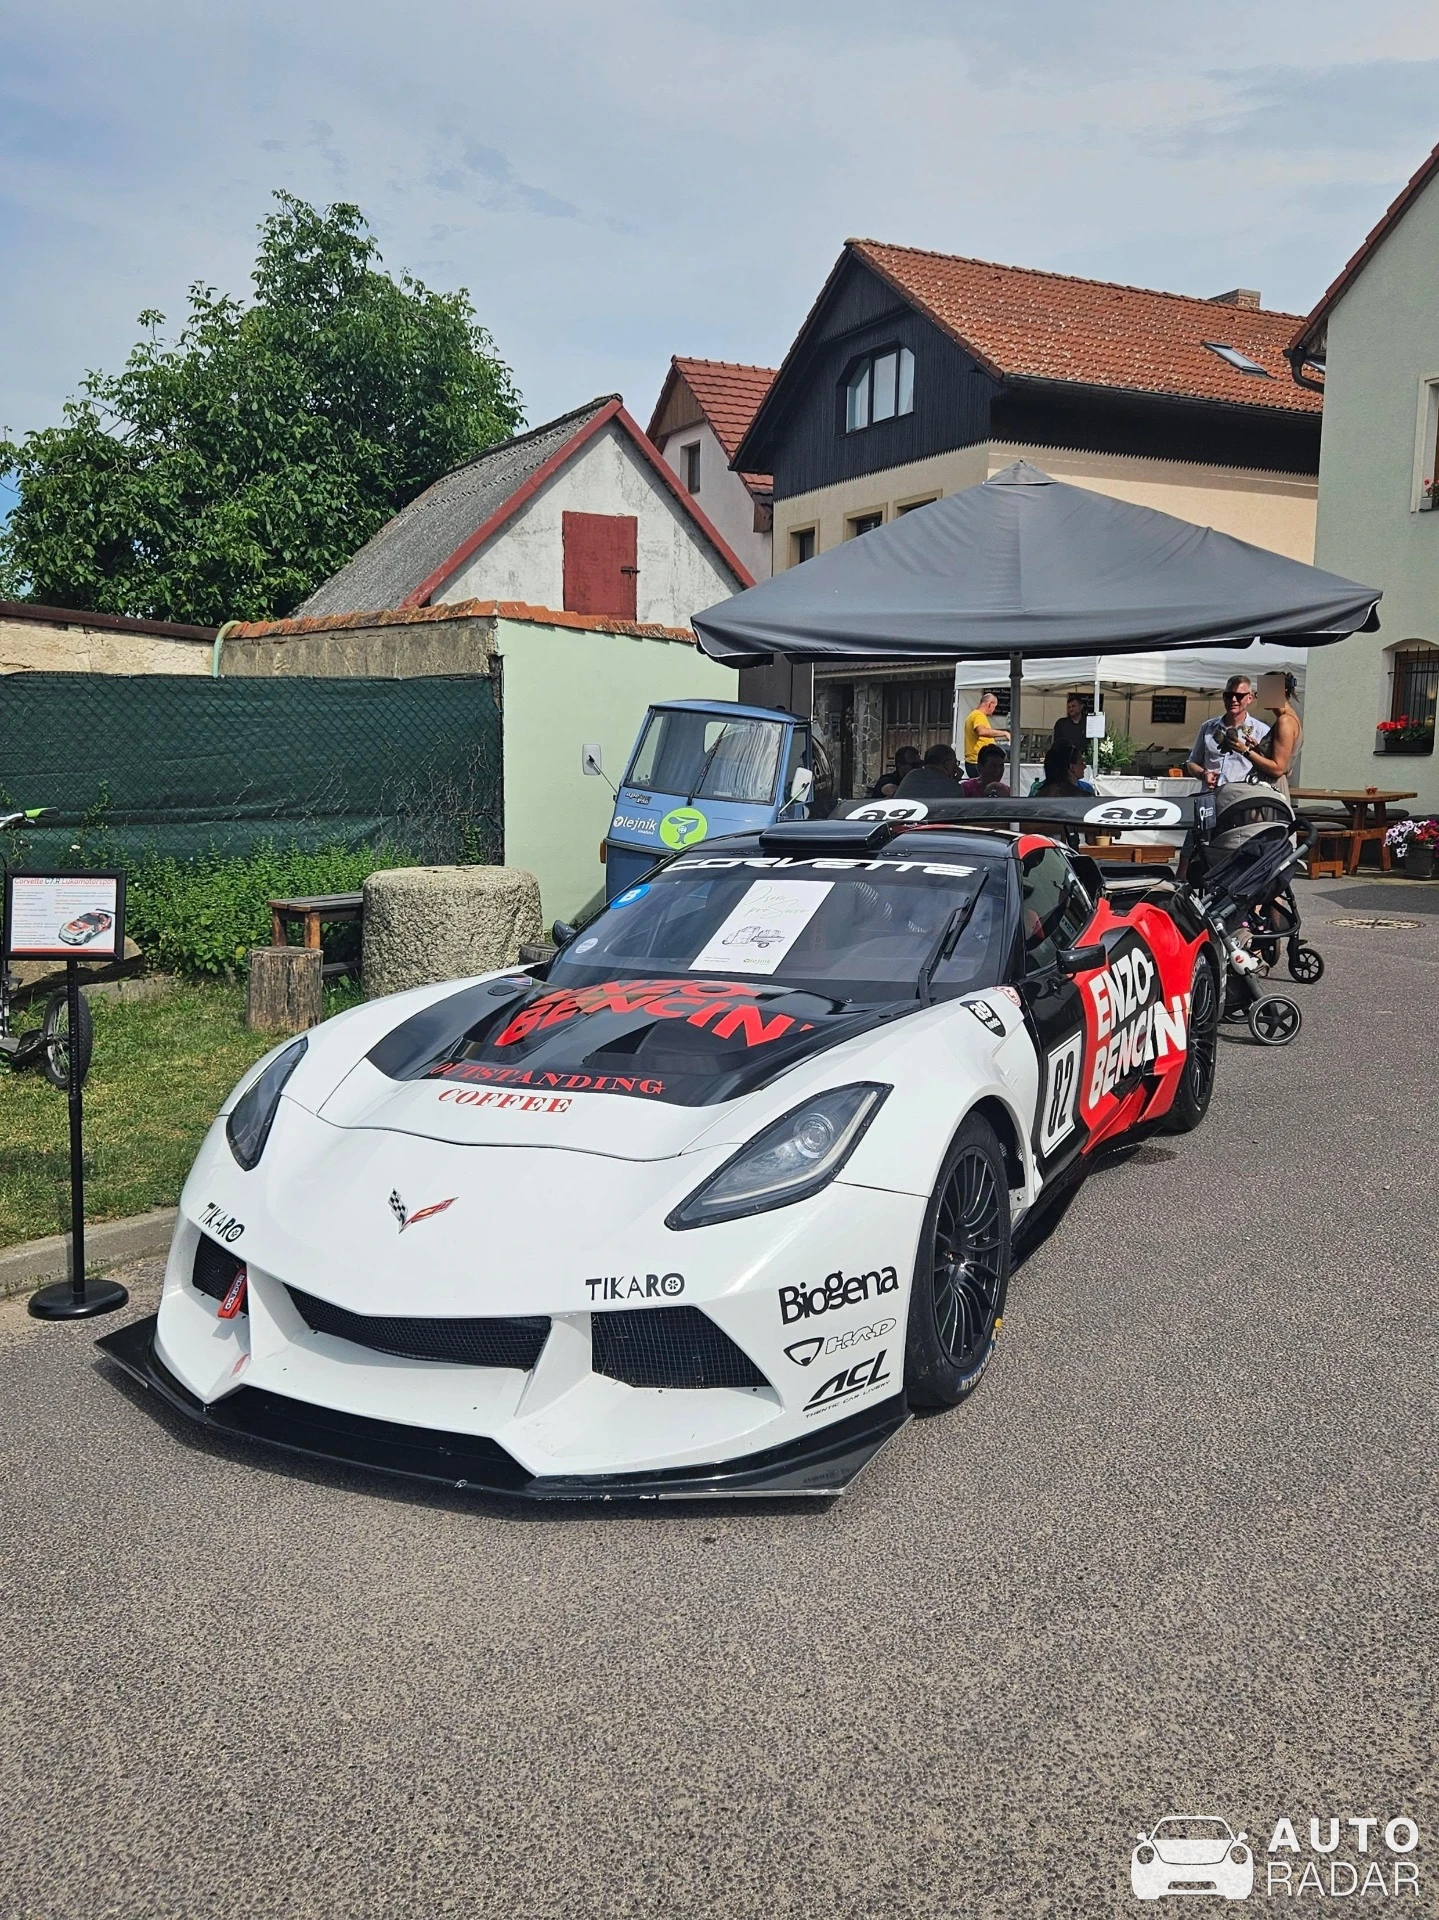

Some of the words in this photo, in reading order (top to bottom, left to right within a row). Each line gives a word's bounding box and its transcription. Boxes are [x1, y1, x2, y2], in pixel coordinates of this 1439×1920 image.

[858, 808, 918, 820] ag
[1100, 807, 1168, 821] ag
[61, 878, 117, 886] Lukamotorspor
[661, 857, 977, 877] CORVETTE
[529, 980, 761, 1008] ENZO
[1089, 948, 1154, 1041] ENZO
[494, 994, 815, 1048] BENCIN
[430, 1062, 666, 1095] OUTSTANDING
[1048, 1050, 1075, 1138] 82
[438, 1088, 573, 1113] COFFEE
[198, 1201, 246, 1243] TIKARO
[225, 1274, 246, 1310] sparco
[585, 1272, 685, 1301] TIKARO
[778, 1265, 899, 1325] Biogena
[804, 1348, 891, 1408] ACL
